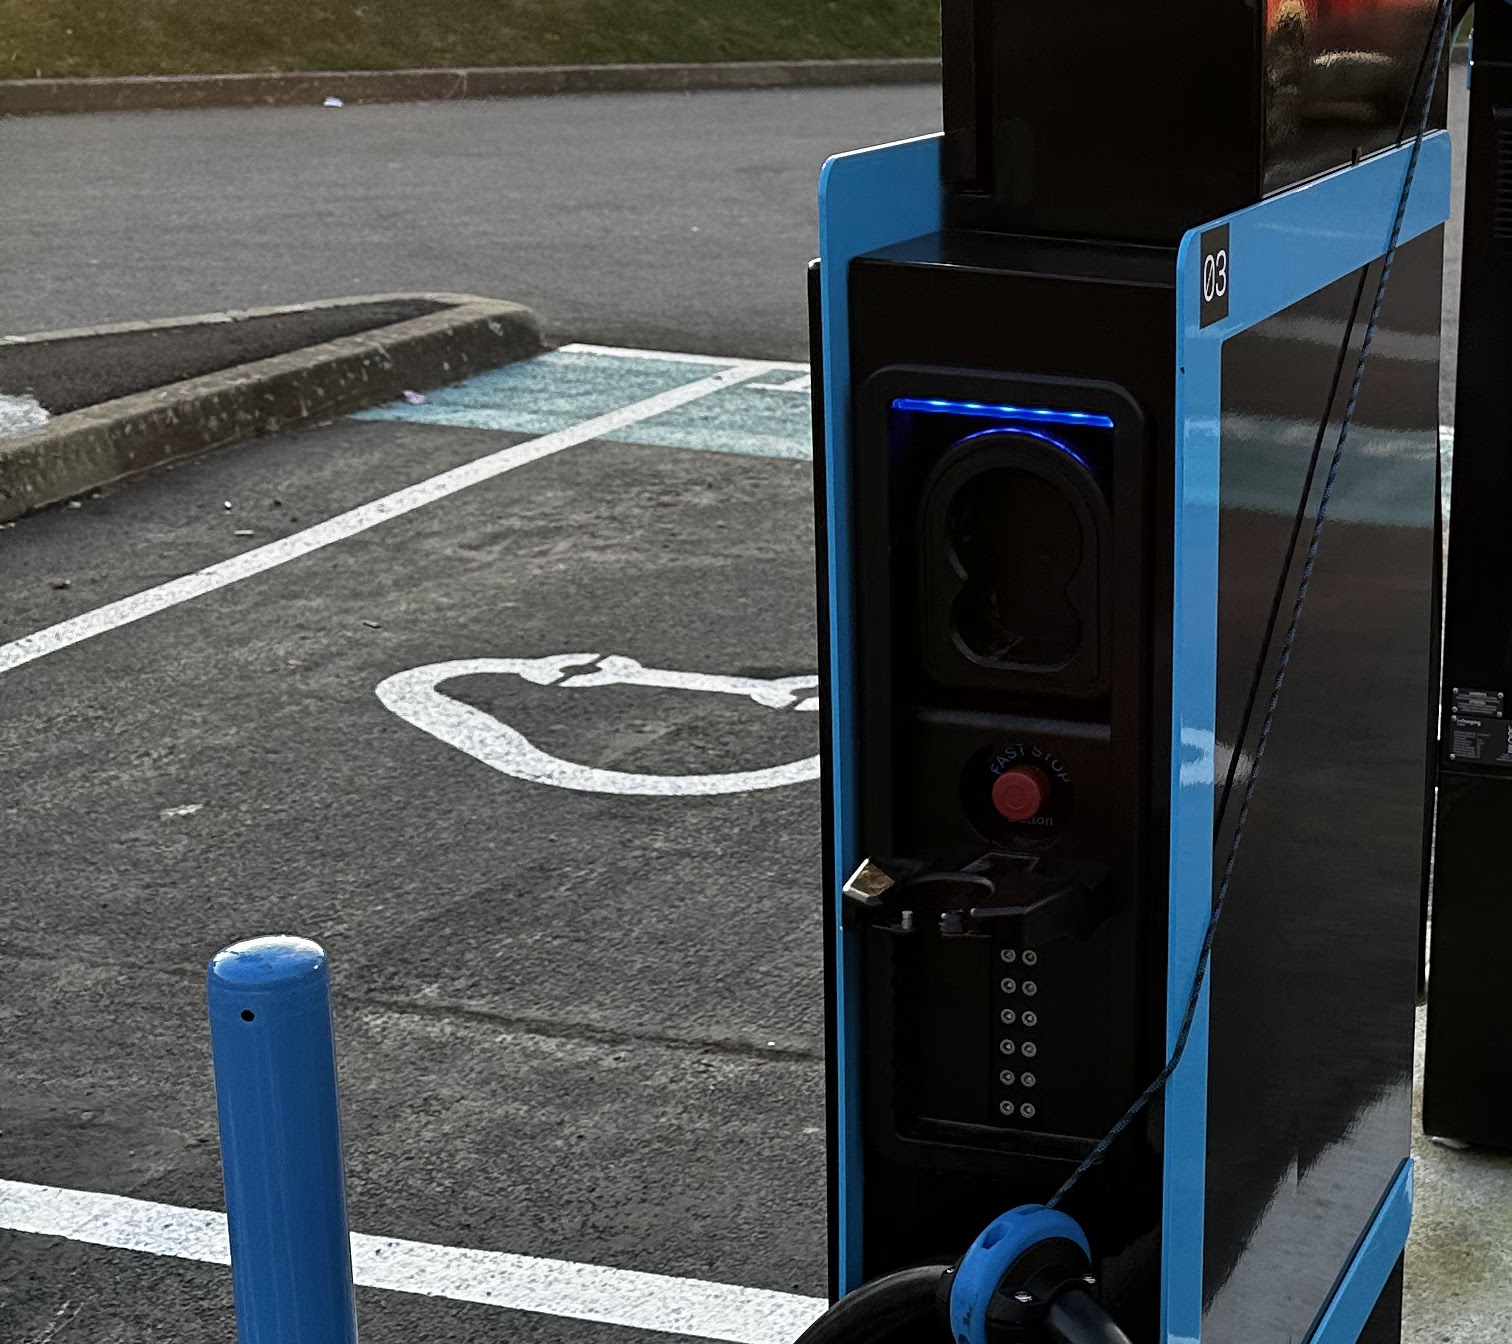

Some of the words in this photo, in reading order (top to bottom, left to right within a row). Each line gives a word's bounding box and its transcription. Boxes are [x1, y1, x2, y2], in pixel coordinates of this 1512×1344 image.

[1203, 249, 1227, 302] 03
[990, 743, 1025, 776] FAST
[1031, 744, 1072, 784] STOP
